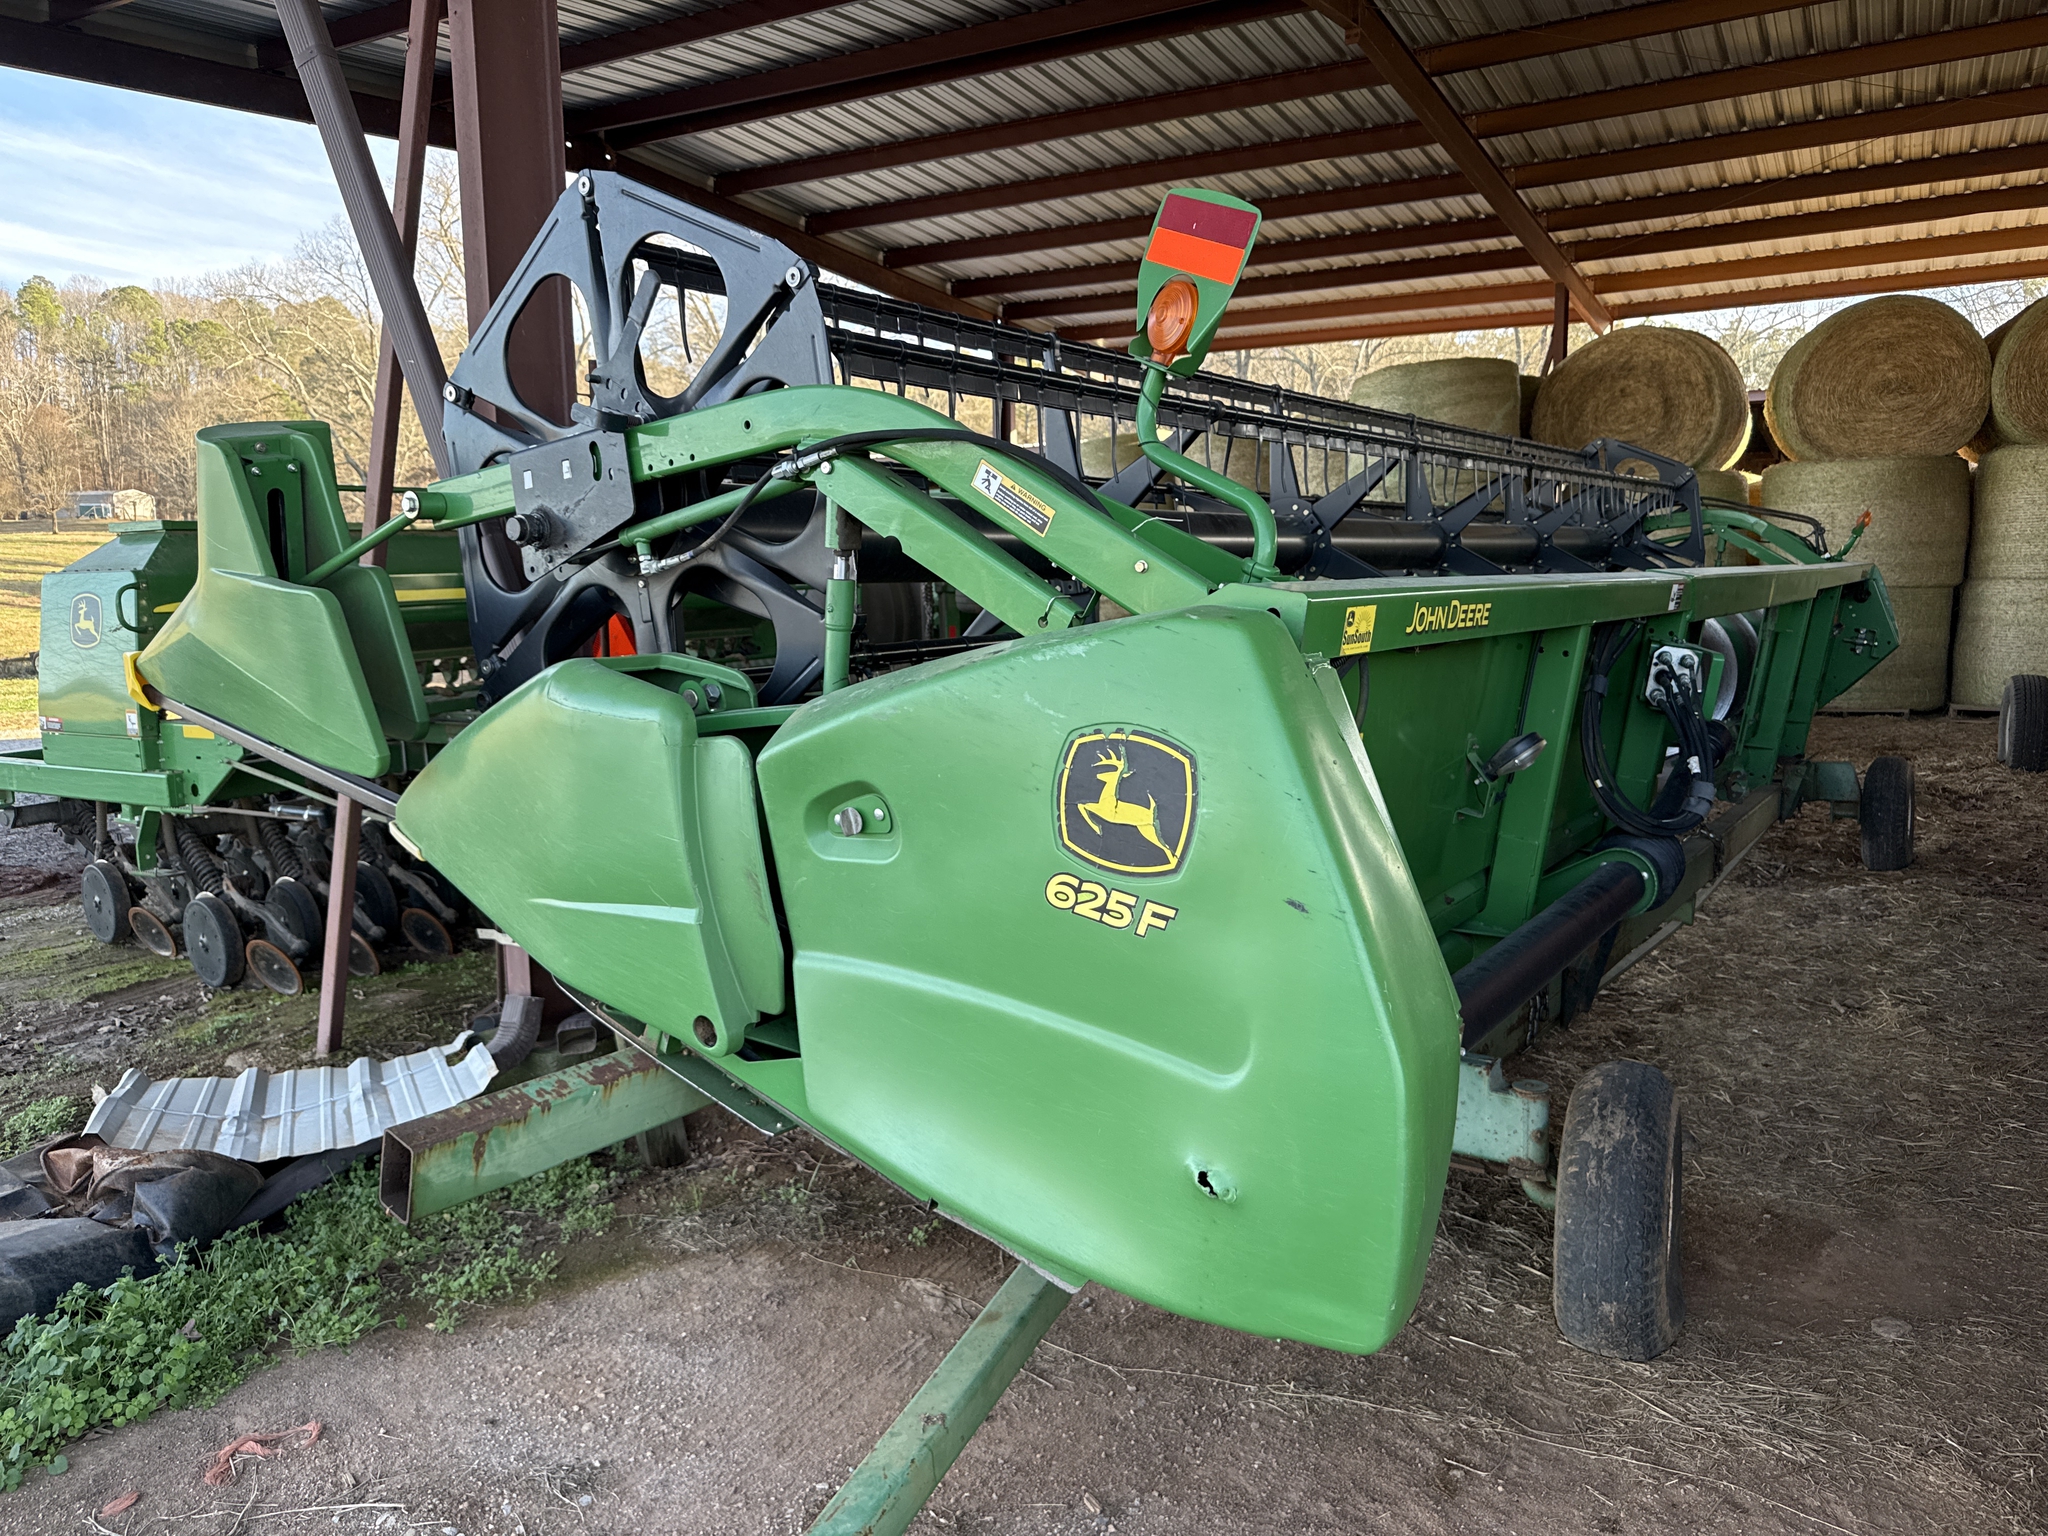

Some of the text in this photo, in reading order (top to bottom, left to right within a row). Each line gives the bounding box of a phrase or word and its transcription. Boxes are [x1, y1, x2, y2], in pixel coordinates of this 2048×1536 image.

[1018, 487, 1046, 511] WARNING
[1405, 599, 1491, 633] JOHN DEERE
[1342, 629, 1371, 645] SunSouth
